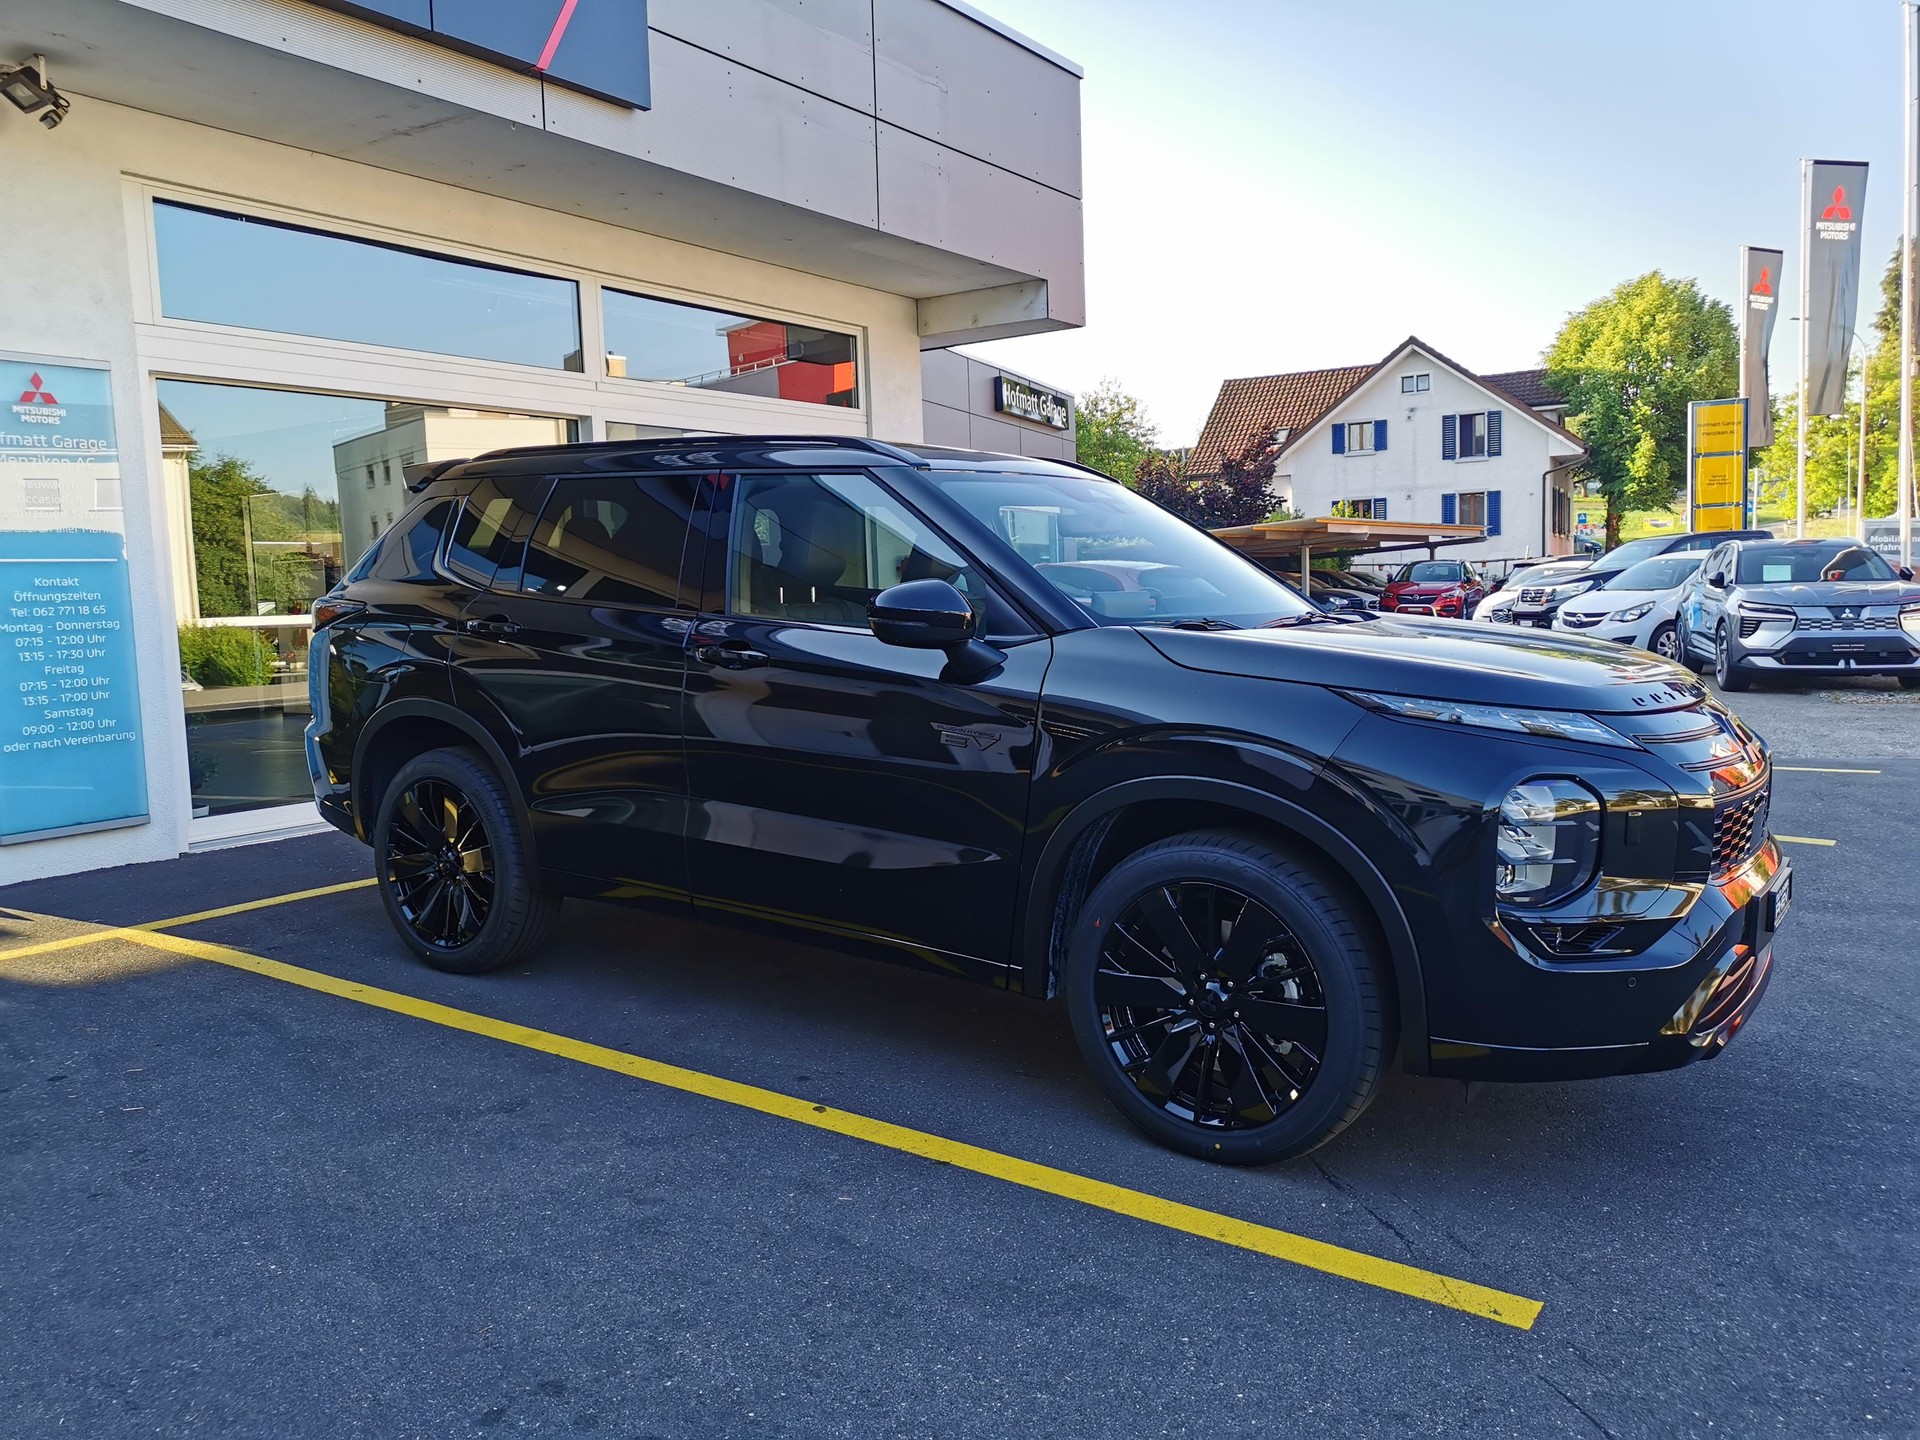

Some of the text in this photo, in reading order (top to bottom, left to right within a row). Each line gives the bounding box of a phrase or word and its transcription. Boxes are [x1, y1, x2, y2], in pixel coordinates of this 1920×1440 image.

[1816, 222, 1856, 231] MITSUBISHI
[1820, 231, 1849, 240] MOTORS
[1003, 382, 1066, 421] Hofmatt Garage
[12, 405, 66, 417] MITSUBISHI
[20, 415, 61, 425] MOTORS
[52, 435, 107, 452] Garage
[34, 577, 79, 587] Kontakt
[13, 590, 101, 603] Öffnungszeiten
[10, 605, 107, 618] Tel: 062 771 18 65
[0, 623, 43, 633] Montag
[56, 620, 120, 631] Donnerstag
[15, 637, 44, 648] 07:15
[56, 635, 84, 646] 12:00
[87, 634, 106, 644] Uhr
[18, 651, 45, 662] 13:15
[57, 649, 84, 660] 17:30
[86, 648, 106, 658] Uhr
[44, 664, 85, 675] Freitag
[20, 681, 48, 692] 07:15
[60, 678, 88, 689] 12:00
[91, 676, 110, 686] Uhr
[22, 695, 49, 706] 13:15
[60, 692, 88, 703] 17:00
[91, 690, 110, 701] Uhr
[44, 707, 94, 720] Samstag
[23, 724, 55, 736] 09:00
[66, 720, 95, 732] 12:00
[98, 718, 117, 729] Uhr
[4, 730, 136, 752] oder nach Vereinbarung
